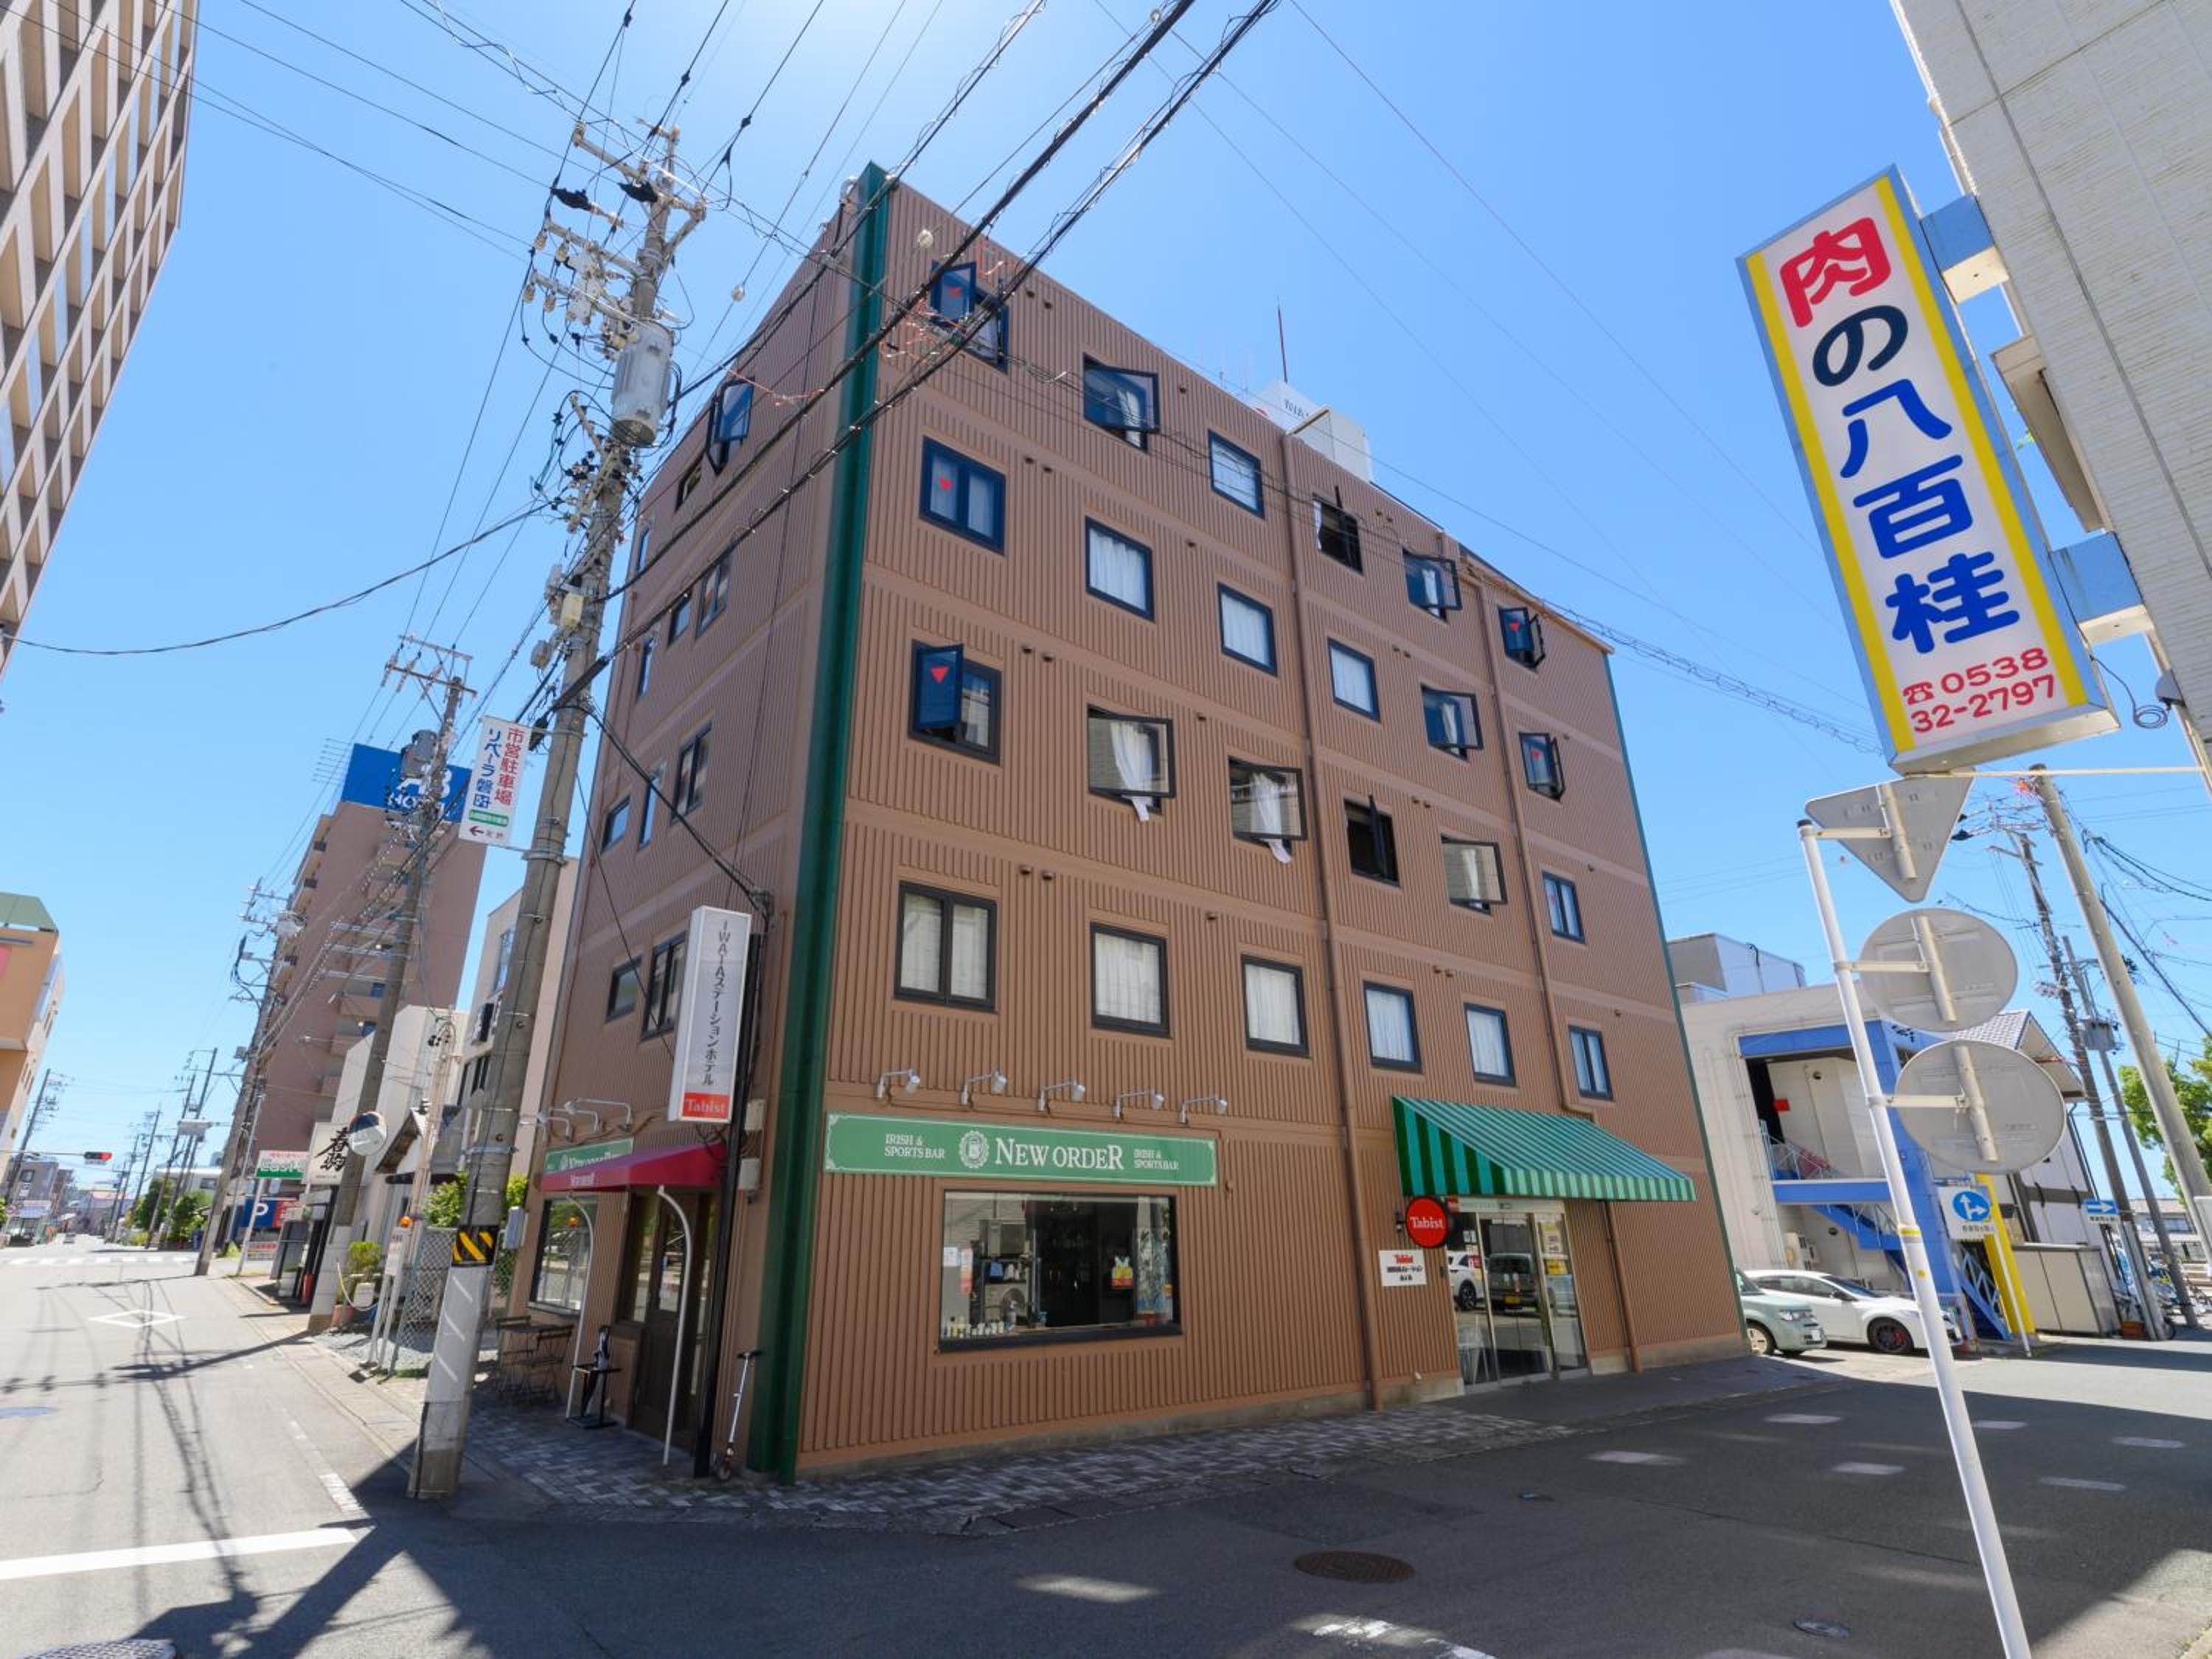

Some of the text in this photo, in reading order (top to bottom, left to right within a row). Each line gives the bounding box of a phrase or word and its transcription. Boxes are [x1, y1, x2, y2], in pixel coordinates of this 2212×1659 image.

[1779, 217, 2020, 654] 肉の八百桂
[1940, 647, 2048, 694] 0538
[1910, 674, 2053, 733] 32-2797
[886, 1133, 914, 1146] IRISH
[1052, 1144, 1125, 1170] ORDER
[1410, 1217, 1444, 1228] Tabist
